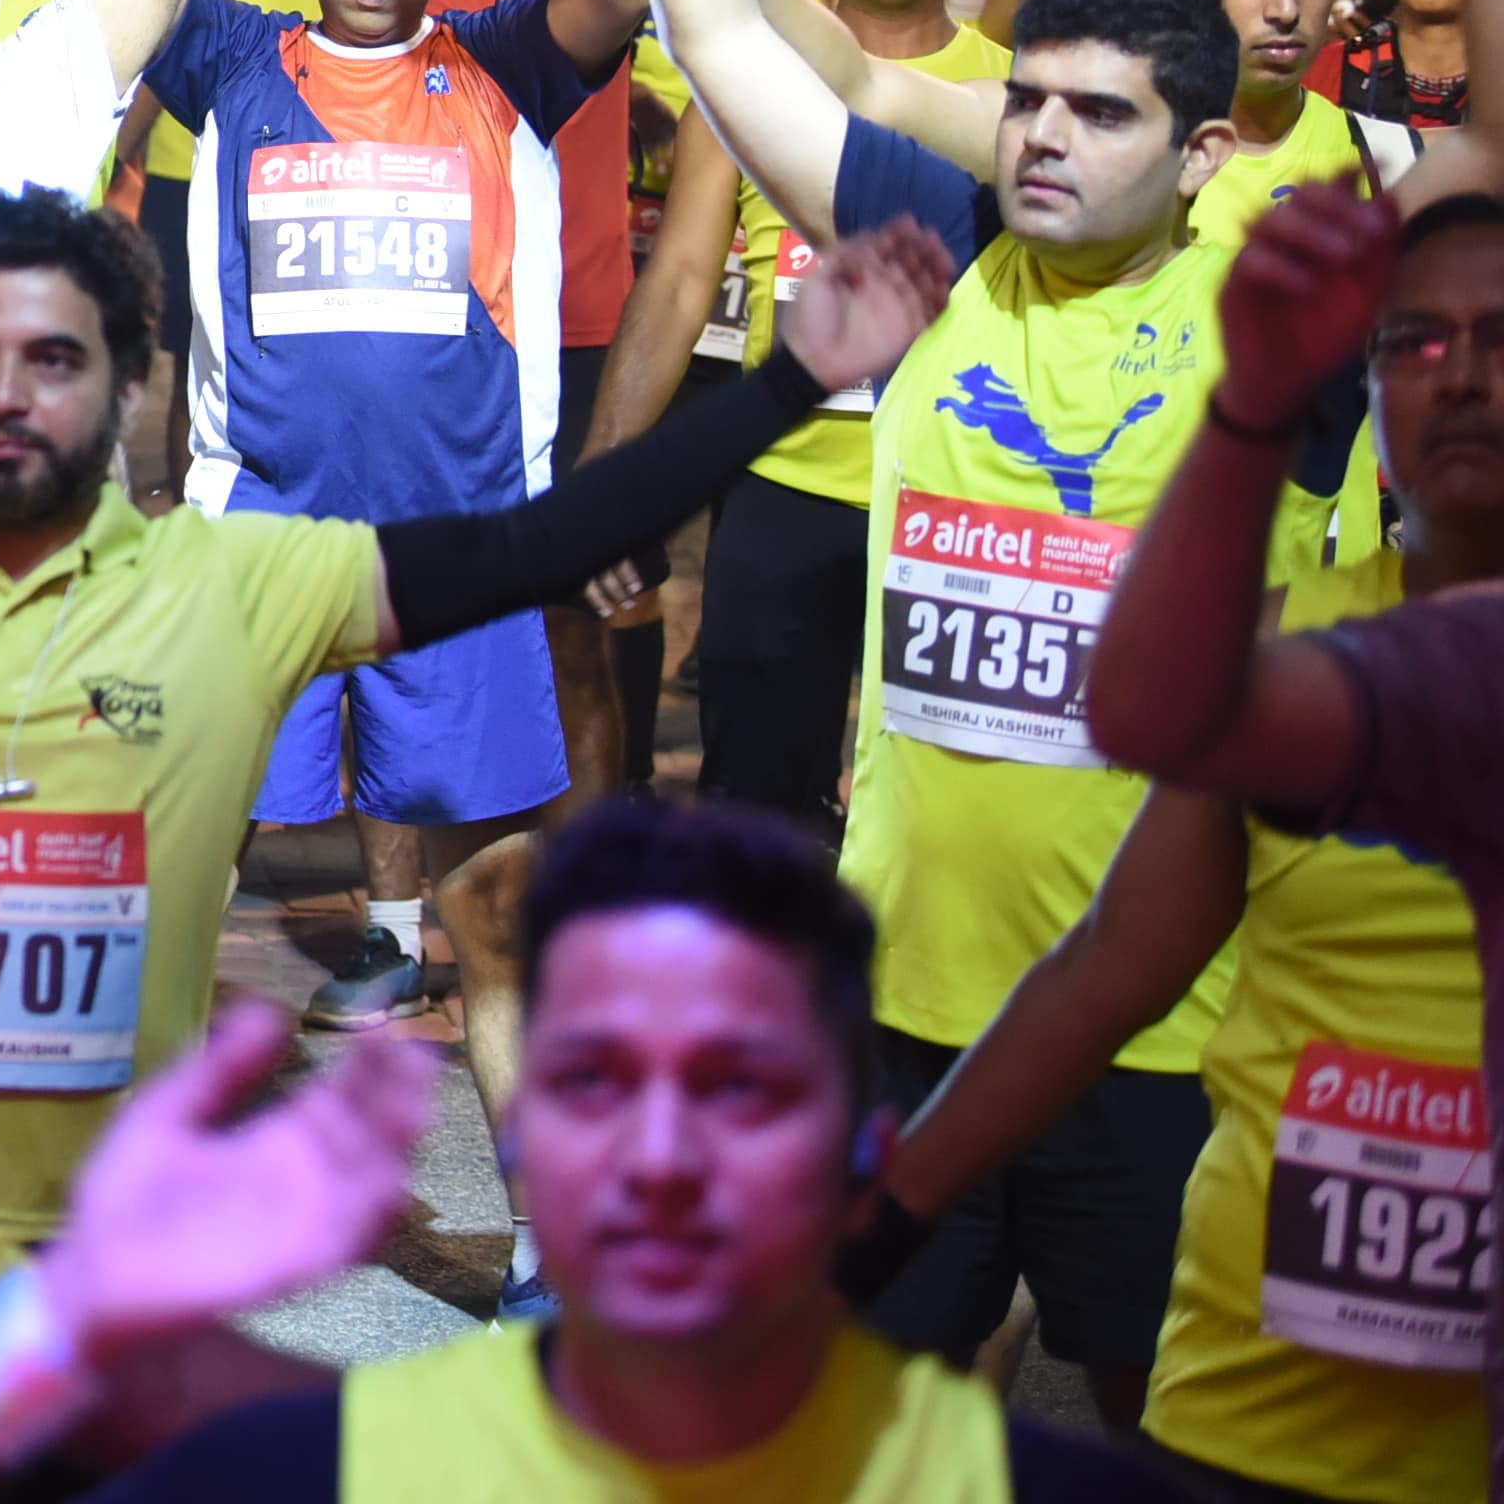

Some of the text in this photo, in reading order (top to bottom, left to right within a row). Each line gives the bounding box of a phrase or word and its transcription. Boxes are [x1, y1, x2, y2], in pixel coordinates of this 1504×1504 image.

[291, 150, 374, 184] airtel
[395, 195, 409, 213] C
[276, 219, 449, 279] 21548
[932, 514, 1034, 568] airtel
[1043, 533, 1111, 554] delhi half
[1041, 548, 1107, 568] marathon
[1051, 590, 1074, 615] D
[920, 703, 1066, 741] RISHIRAJ VASHISHT
[115, 894, 135, 916] V
[1344, 1075, 1474, 1136] airtel
